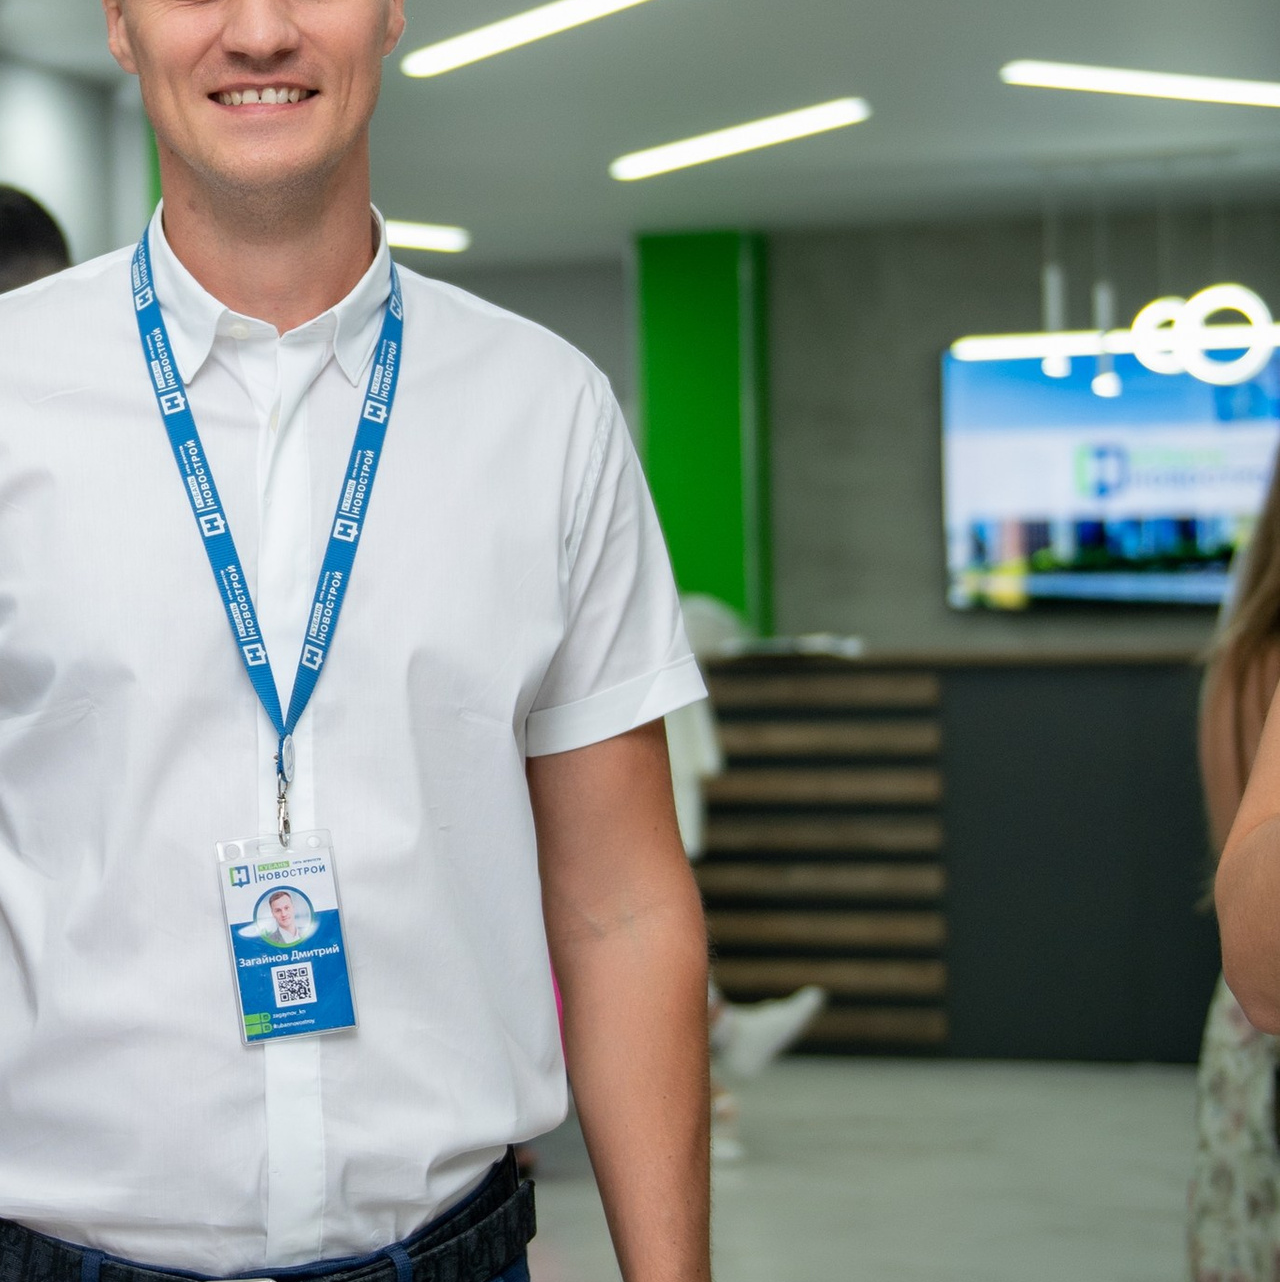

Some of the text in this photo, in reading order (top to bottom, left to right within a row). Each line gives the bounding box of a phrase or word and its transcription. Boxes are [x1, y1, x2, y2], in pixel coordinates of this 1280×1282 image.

[150, 327, 176, 386] НОВОСТРОЙ
[380, 340, 397, 399] НОВОСТРОЙ
[184, 439, 215, 506] НОВОСТРОЙ
[188, 476, 204, 507] КУБАНЬ
[342, 480, 356, 511] КУБАНЬ
[352, 450, 375, 515] НОВОСТРОЙ
[226, 565, 256, 636] НОВОСТРОЙ
[231, 603, 246, 637] КУБАНЬ
[309, 603, 323, 636] КУБАНЬ
[318, 571, 343, 641] НОВОСТРОЙ
[259, 863, 326, 882] НОВОСТРОЙ
[238, 943, 340, 967] Загайнов Дмитрий
